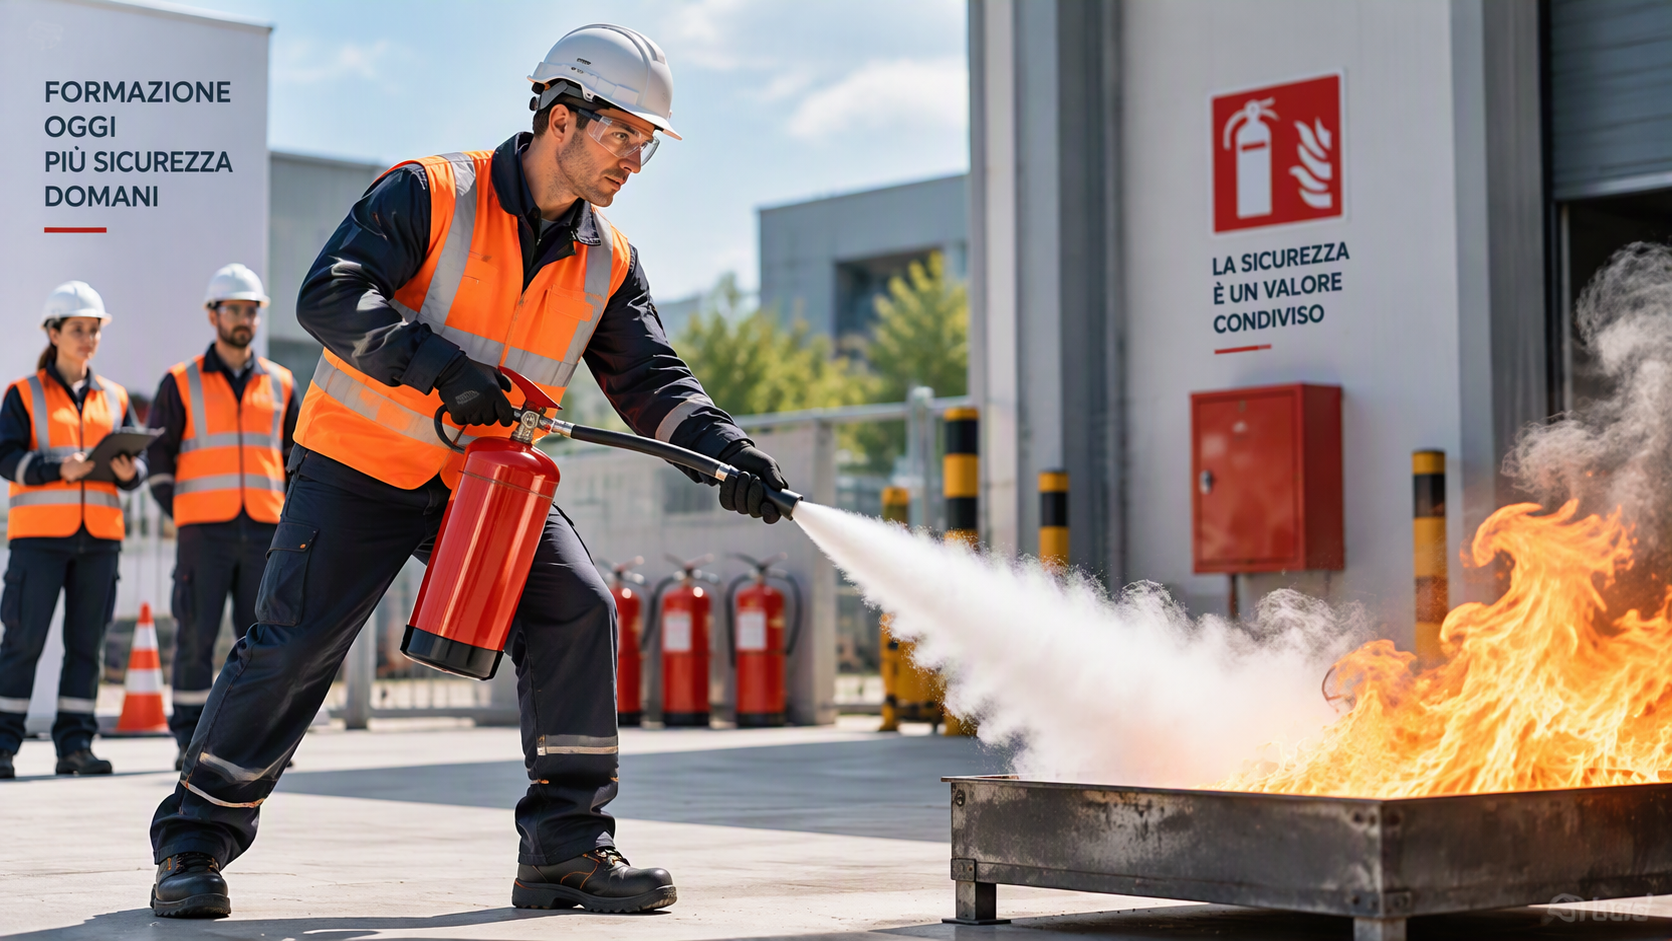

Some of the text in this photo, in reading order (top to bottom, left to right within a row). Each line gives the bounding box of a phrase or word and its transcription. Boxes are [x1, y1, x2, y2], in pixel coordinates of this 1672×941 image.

[46, 81, 230, 102] FORMAZIONE
[45, 116, 115, 137] OGGI
[46, 146, 233, 172] PIÙ SICUREZZA
[46, 186, 157, 207] DOMANI
[1213, 242, 1349, 275] LA SICUREZZA
[1214, 272, 1342, 305] È UN VALORE
[1214, 304, 1324, 333] CONDIVISO
